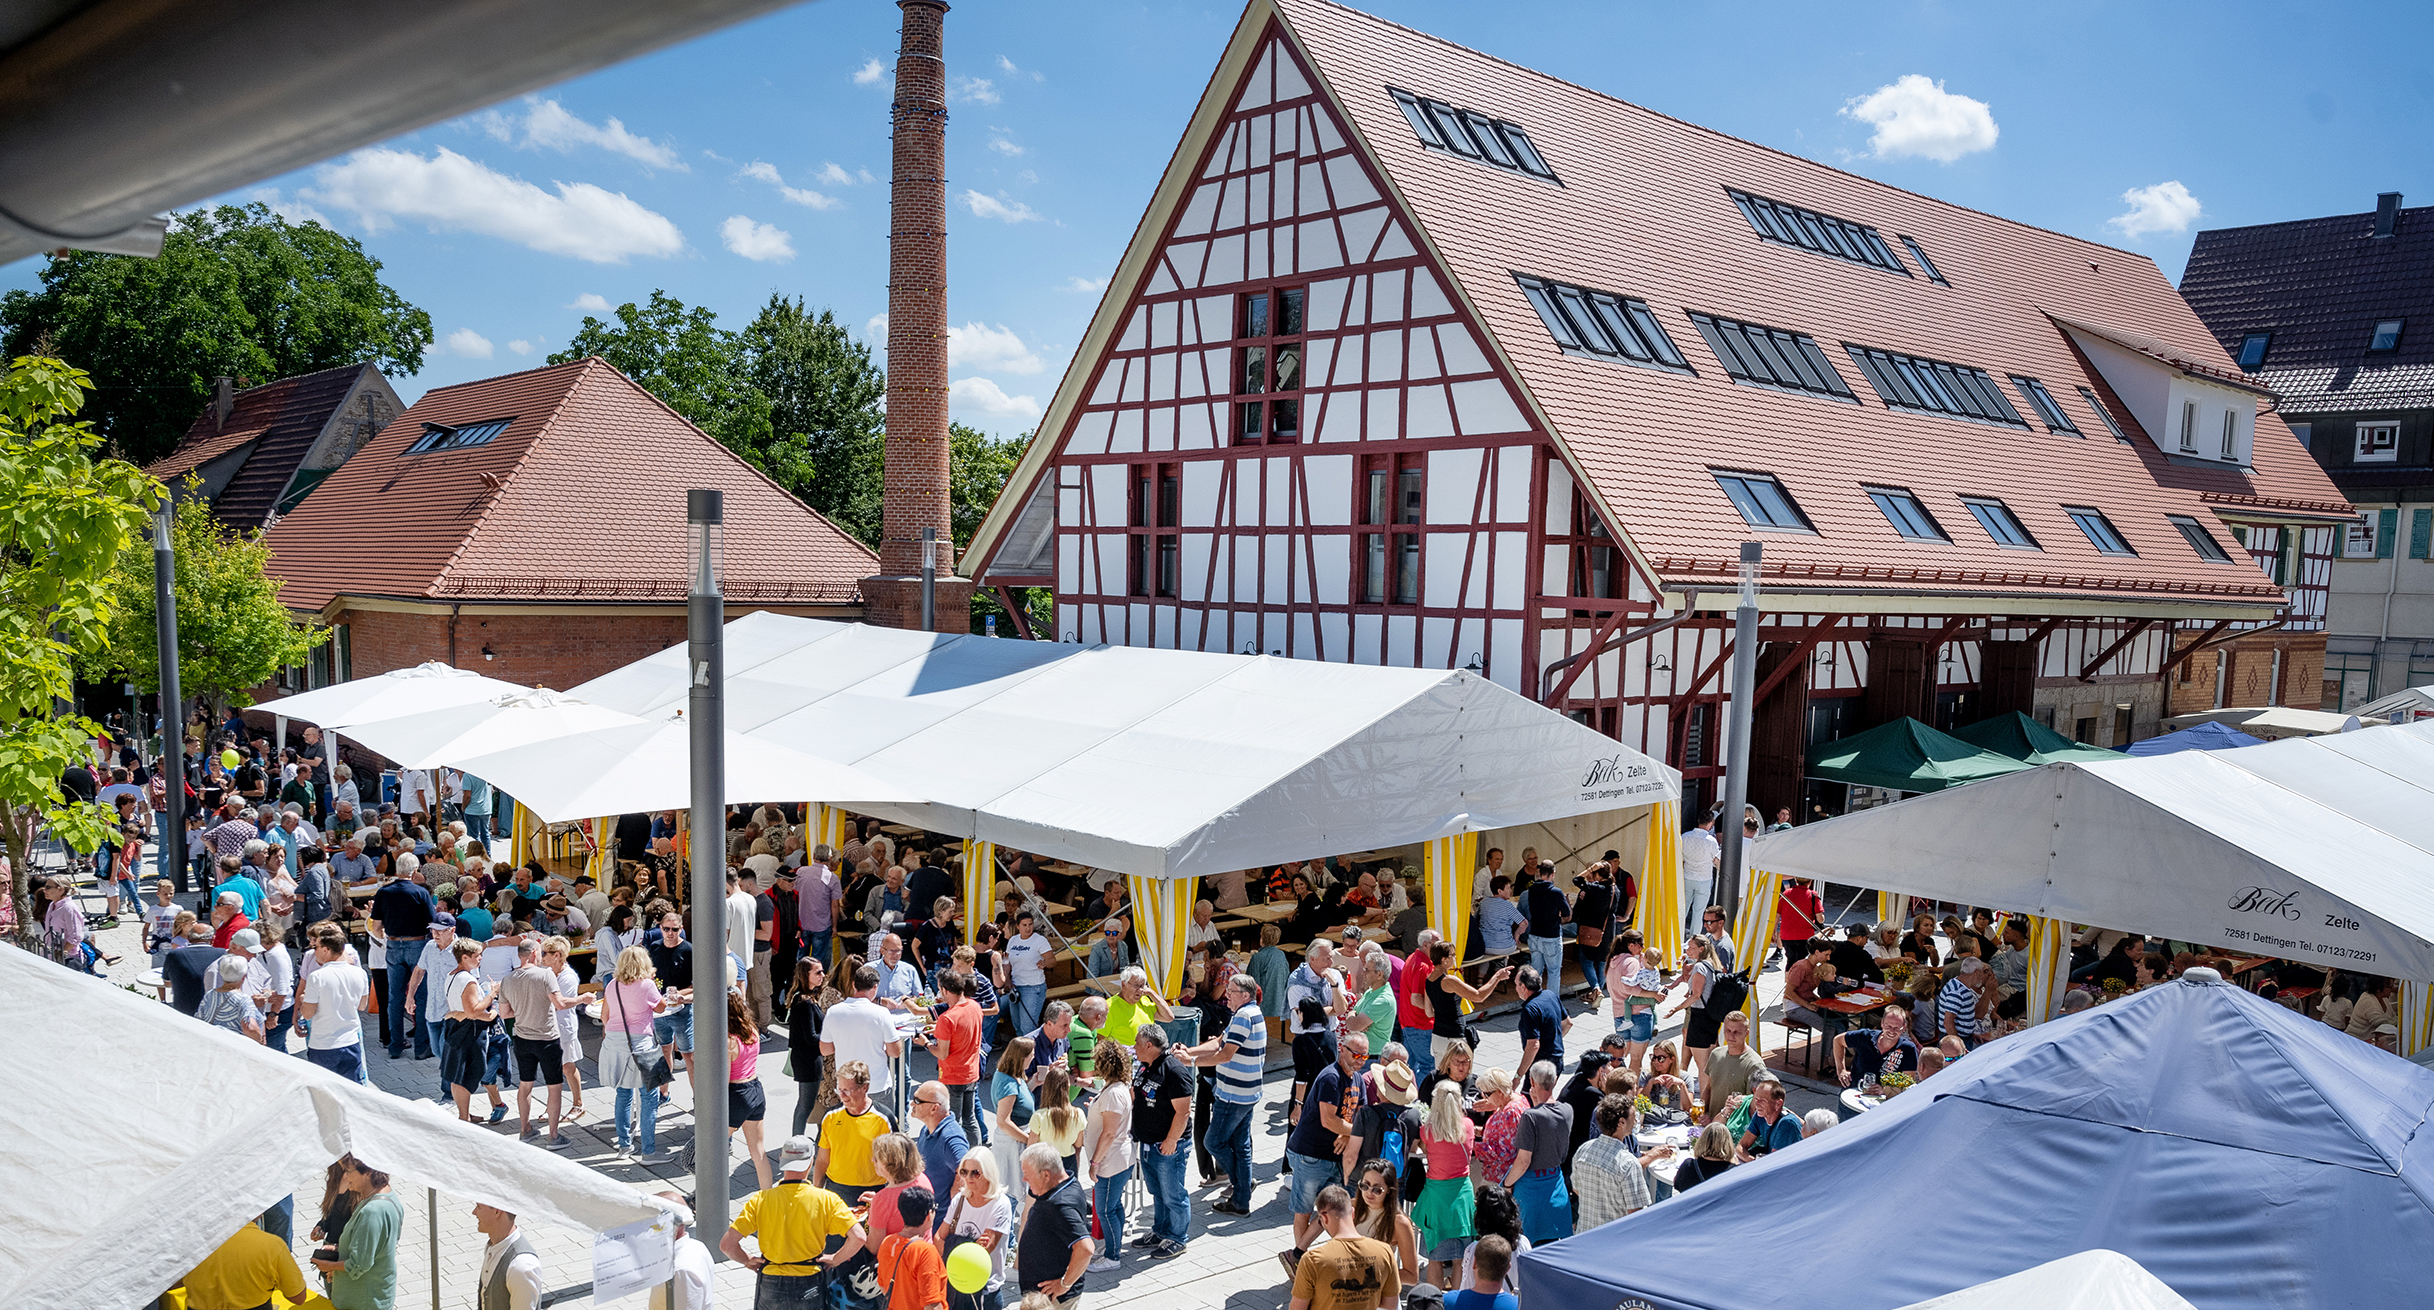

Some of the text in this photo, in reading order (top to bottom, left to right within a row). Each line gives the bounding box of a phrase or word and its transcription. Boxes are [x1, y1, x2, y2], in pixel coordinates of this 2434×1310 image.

[1582, 754, 1647, 787] Beck Zelte
[1581, 781, 1665, 801] 72581 Dettingen Tel. 071237229
[2227, 886, 2360, 930] Beck Zelte
[2224, 927, 2377, 962] 72581 Dettingen Tel. 07123/72291
[613, 1233, 626, 1241] 2022
